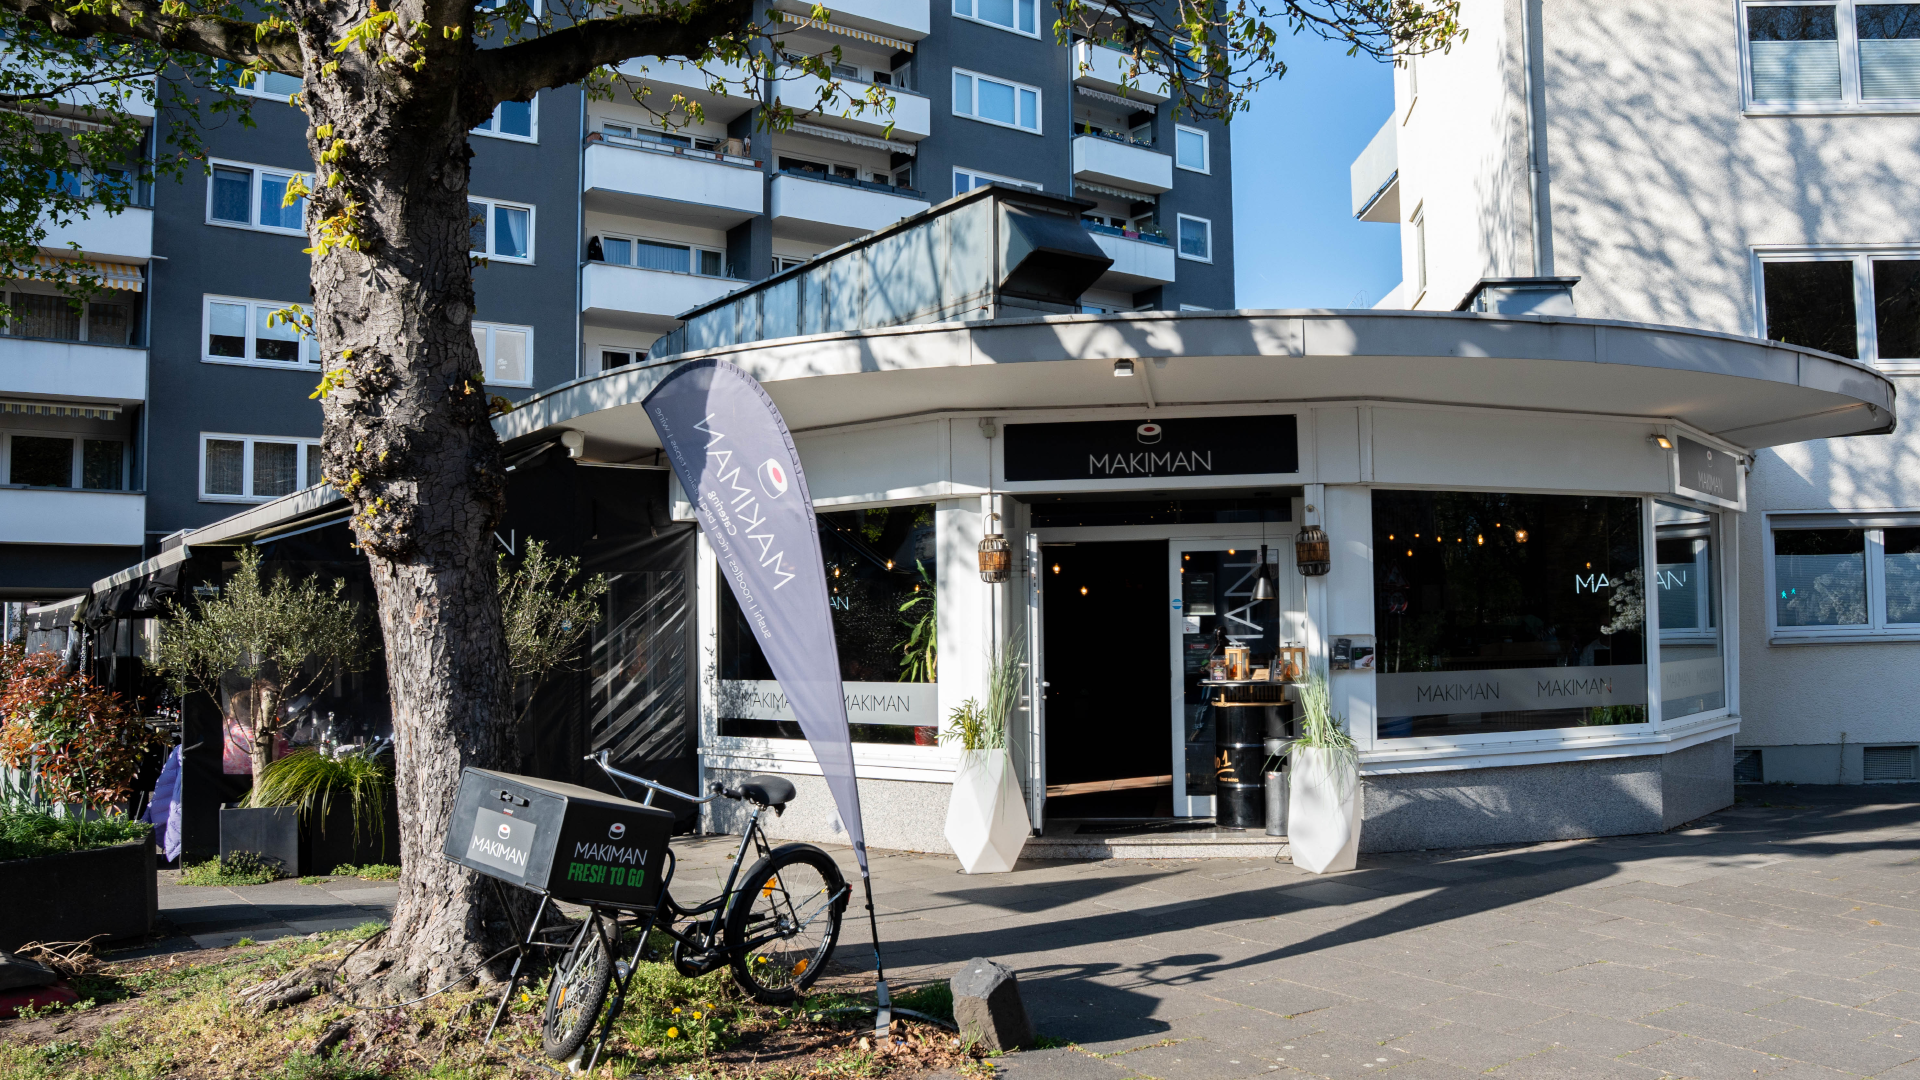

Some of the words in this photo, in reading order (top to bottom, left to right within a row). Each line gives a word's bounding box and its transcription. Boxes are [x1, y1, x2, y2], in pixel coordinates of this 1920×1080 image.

[1089, 450, 1212, 475] MAKIMAN
[1697, 470, 1723, 494] MAKIMAN
[1417, 681, 1500, 703] MAKIMAN
[1537, 677, 1613, 699] MAKIMAN
[472, 834, 527, 867] MAKIMAN
[574, 841, 648, 866] MAKIMAN
[567, 861, 606, 884] FRESH
[609, 866, 626, 886] TO
[627, 868, 645, 888] GO
